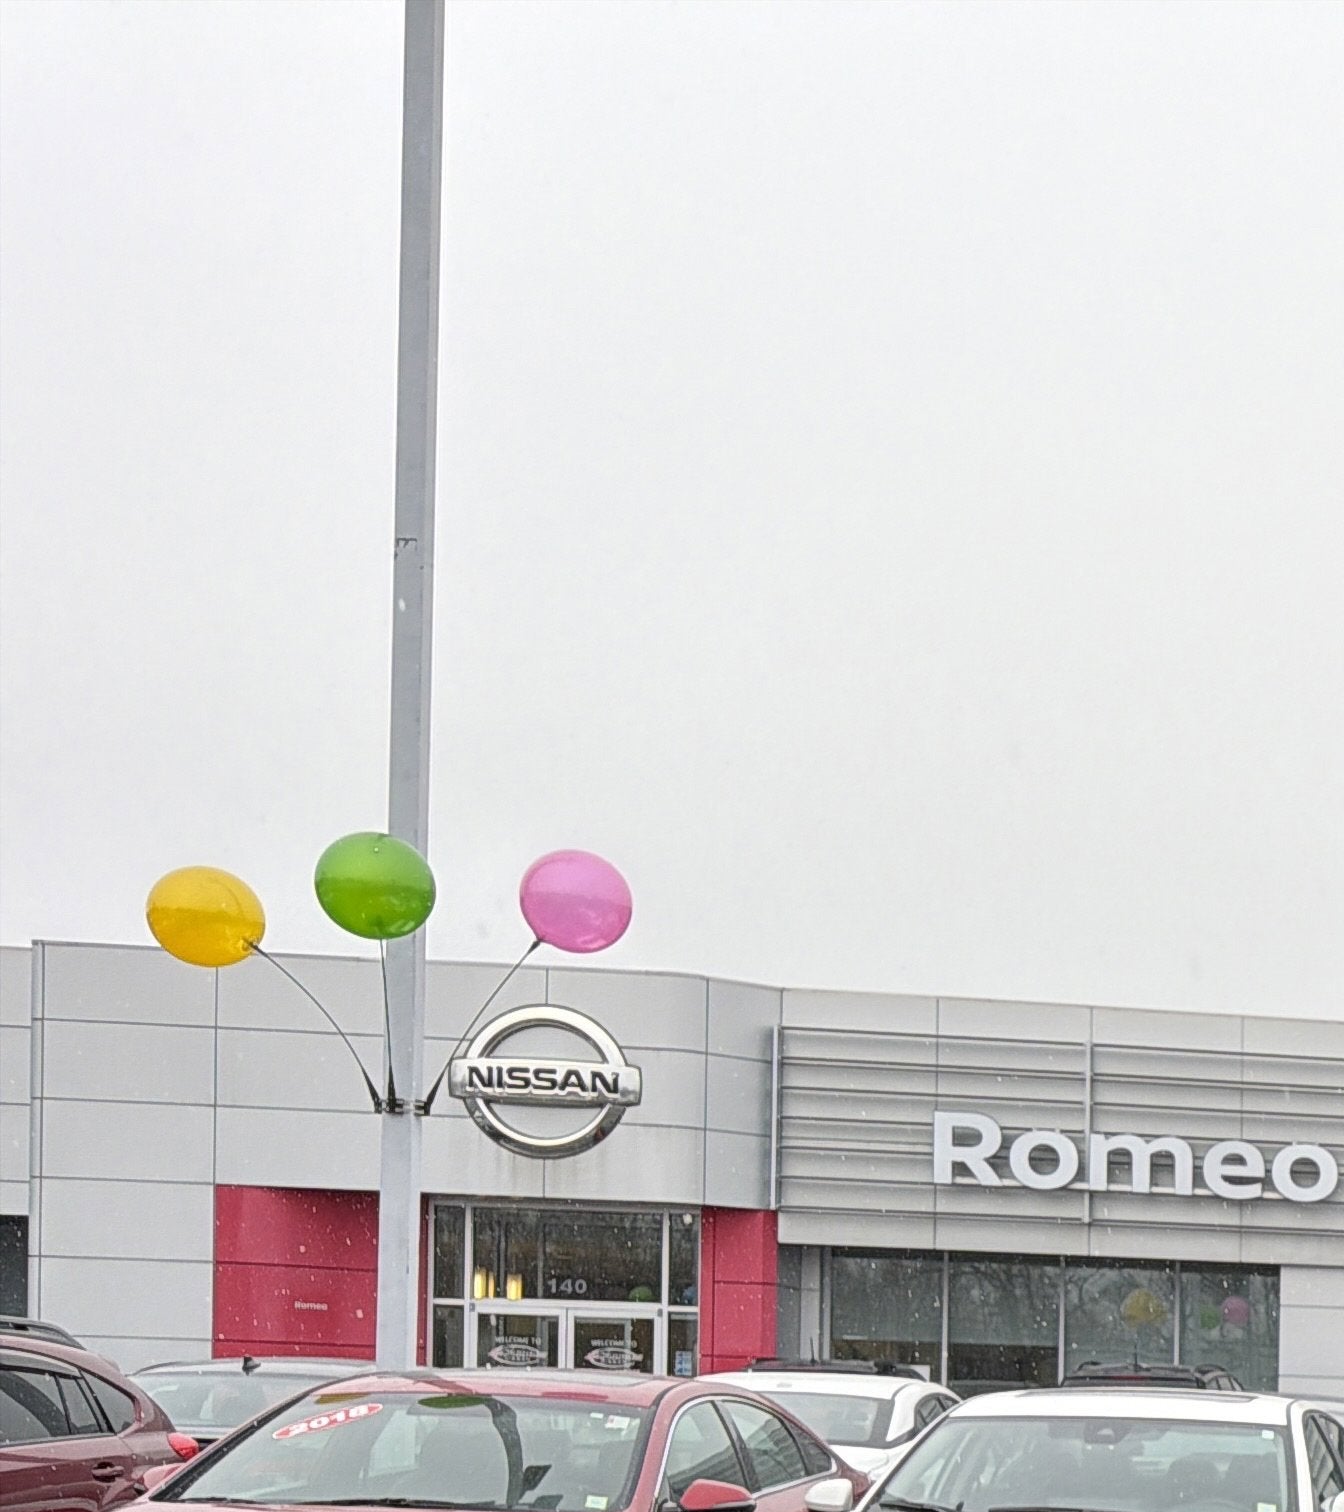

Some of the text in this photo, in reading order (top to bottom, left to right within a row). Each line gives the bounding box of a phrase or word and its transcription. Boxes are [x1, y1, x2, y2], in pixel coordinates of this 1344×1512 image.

[466, 1065, 620, 1095] NISSAN
[933, 1110, 1338, 1203] Romeo
[548, 1278, 588, 1295] 140
[289, 1404, 369, 1435] 2018
